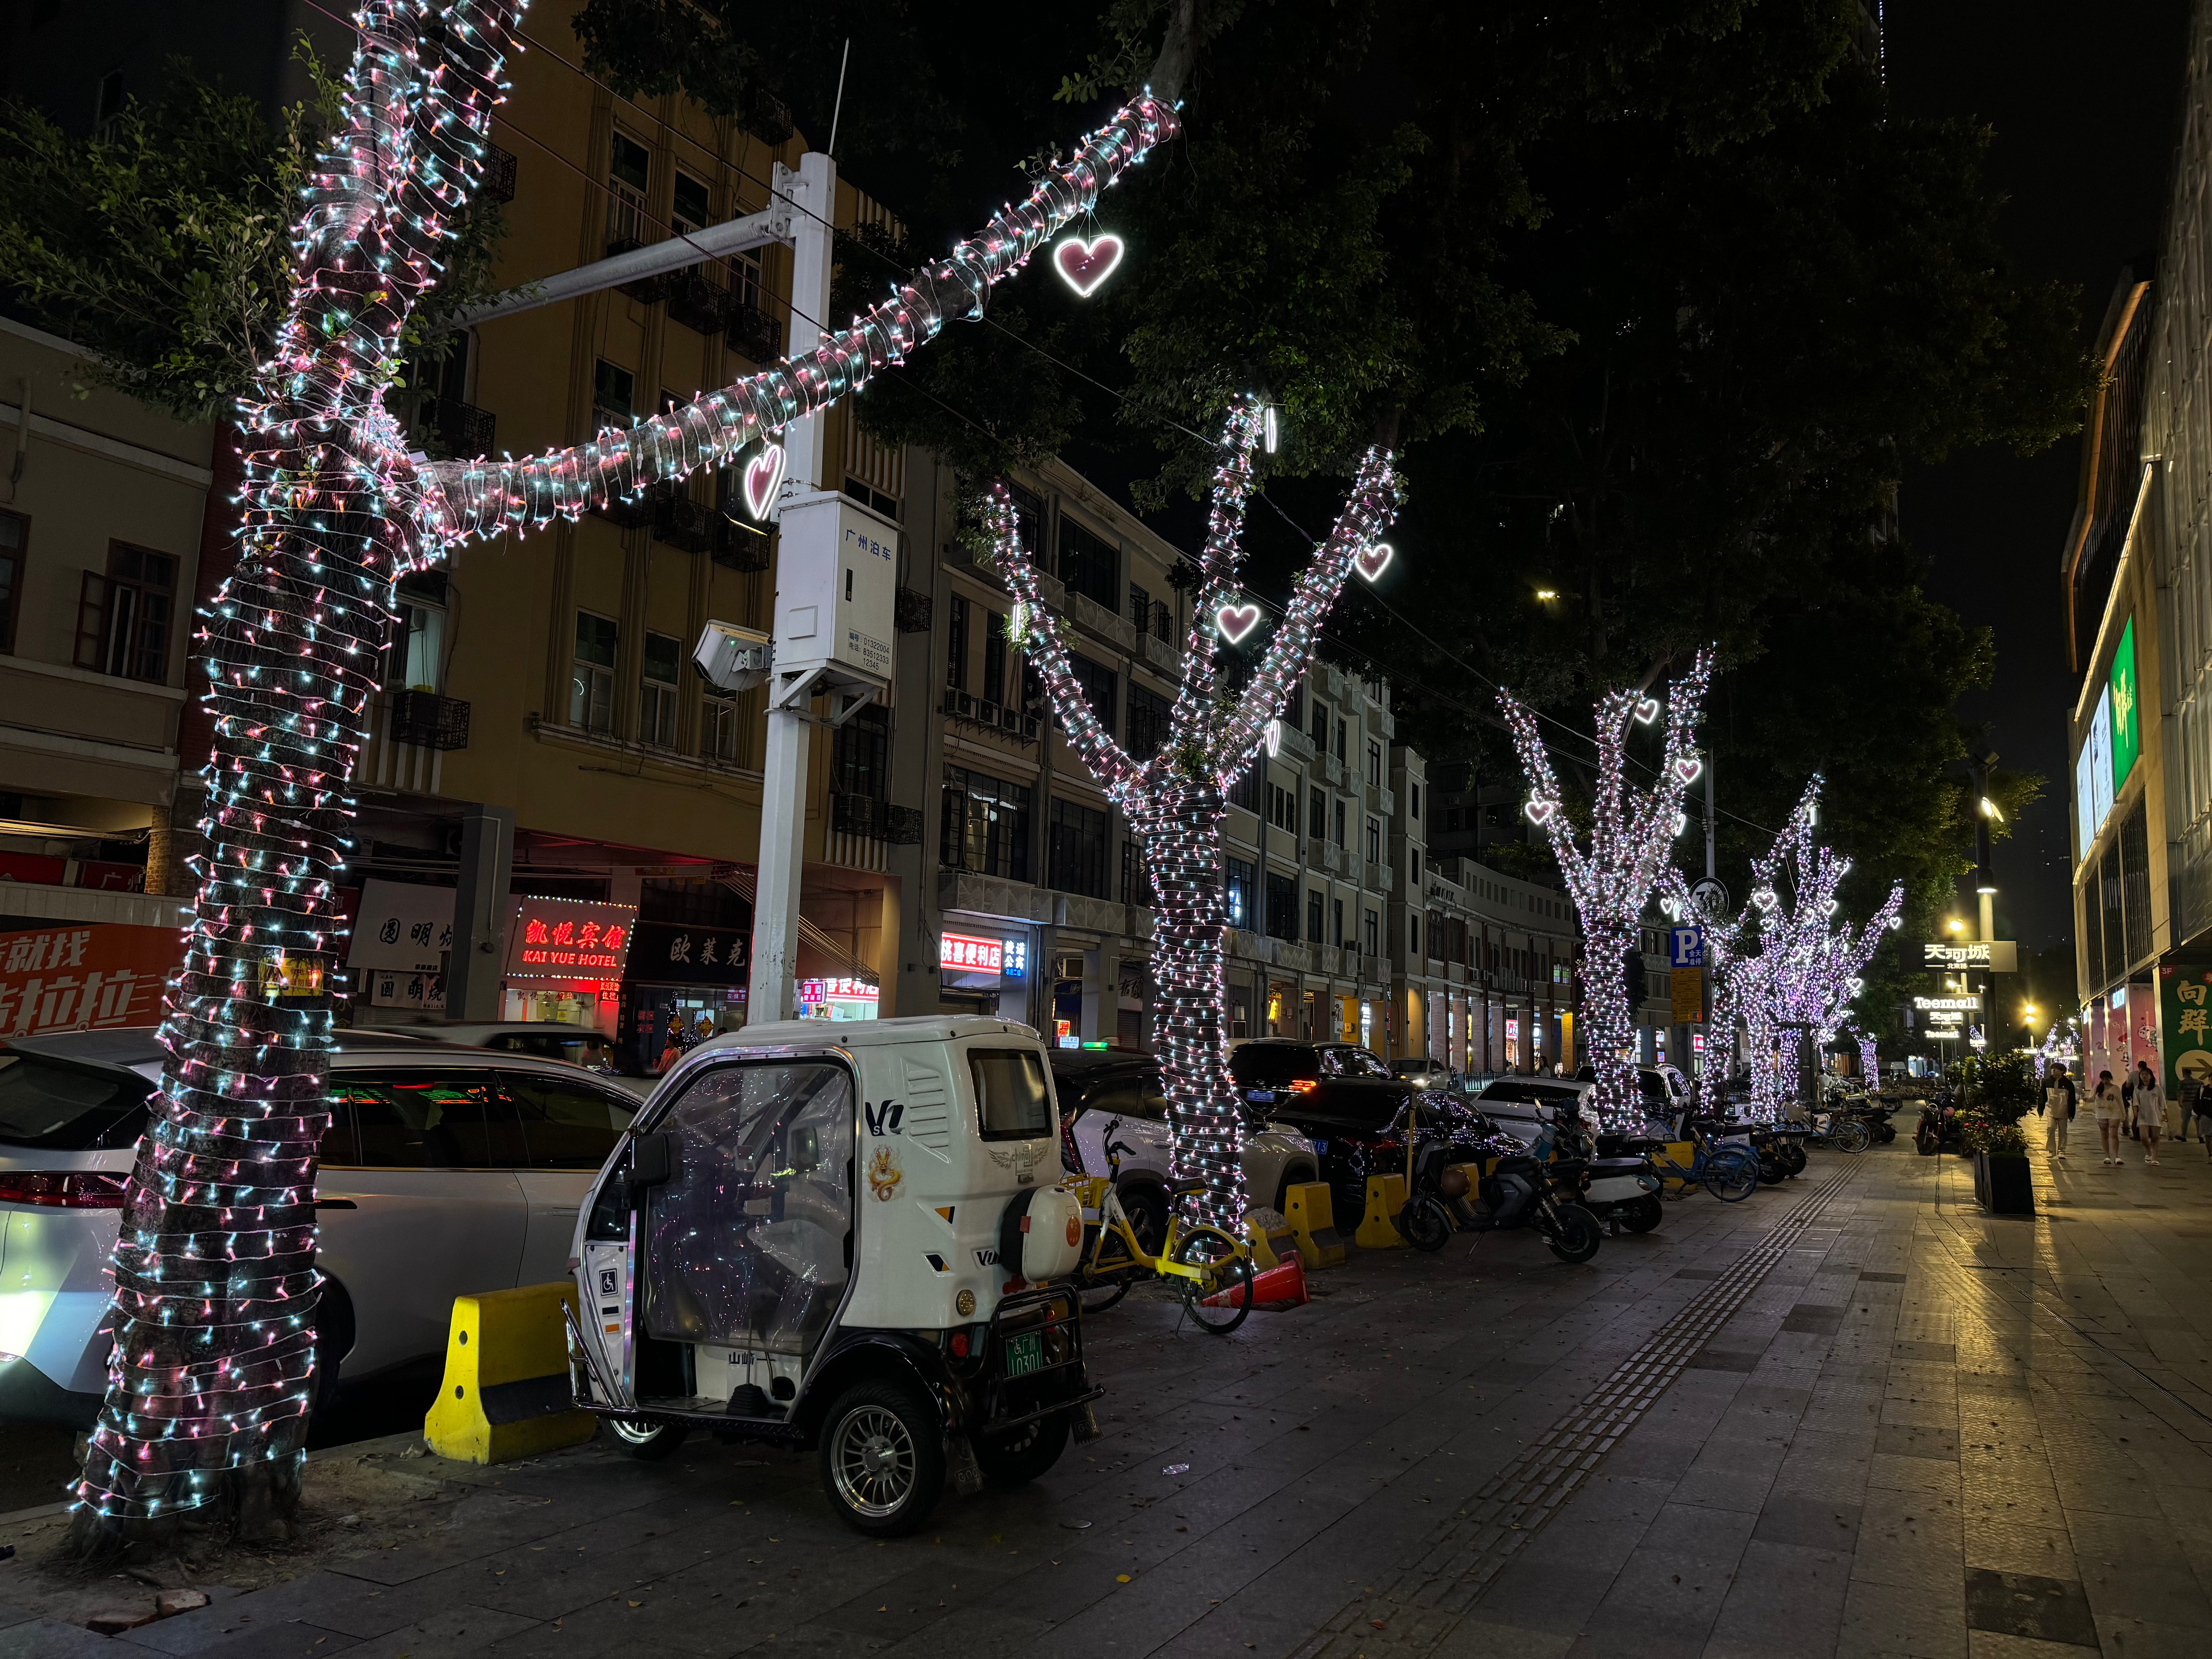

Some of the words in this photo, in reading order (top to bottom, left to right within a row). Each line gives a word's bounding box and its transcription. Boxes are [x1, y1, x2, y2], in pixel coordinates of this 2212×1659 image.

[845, 529, 891, 561] 广州泊车
[864, 637, 890, 654] 01322004
[863, 648, 889, 665] 83512333
[863, 658, 879, 670] 12345
[525, 919, 626, 950] 凯悦宾馆
[0, 930, 90, 972] 就找
[1676, 929, 1698, 964] P
[1925, 944, 1990, 963] 天河城
[522, 950, 548, 963] KAI
[550, 952, 575, 965] YUE
[577, 953, 618, 968] HOTEL
[1914, 997, 1978, 1009] Teemall
[1023, 1333, 1036, 1353] 广州
